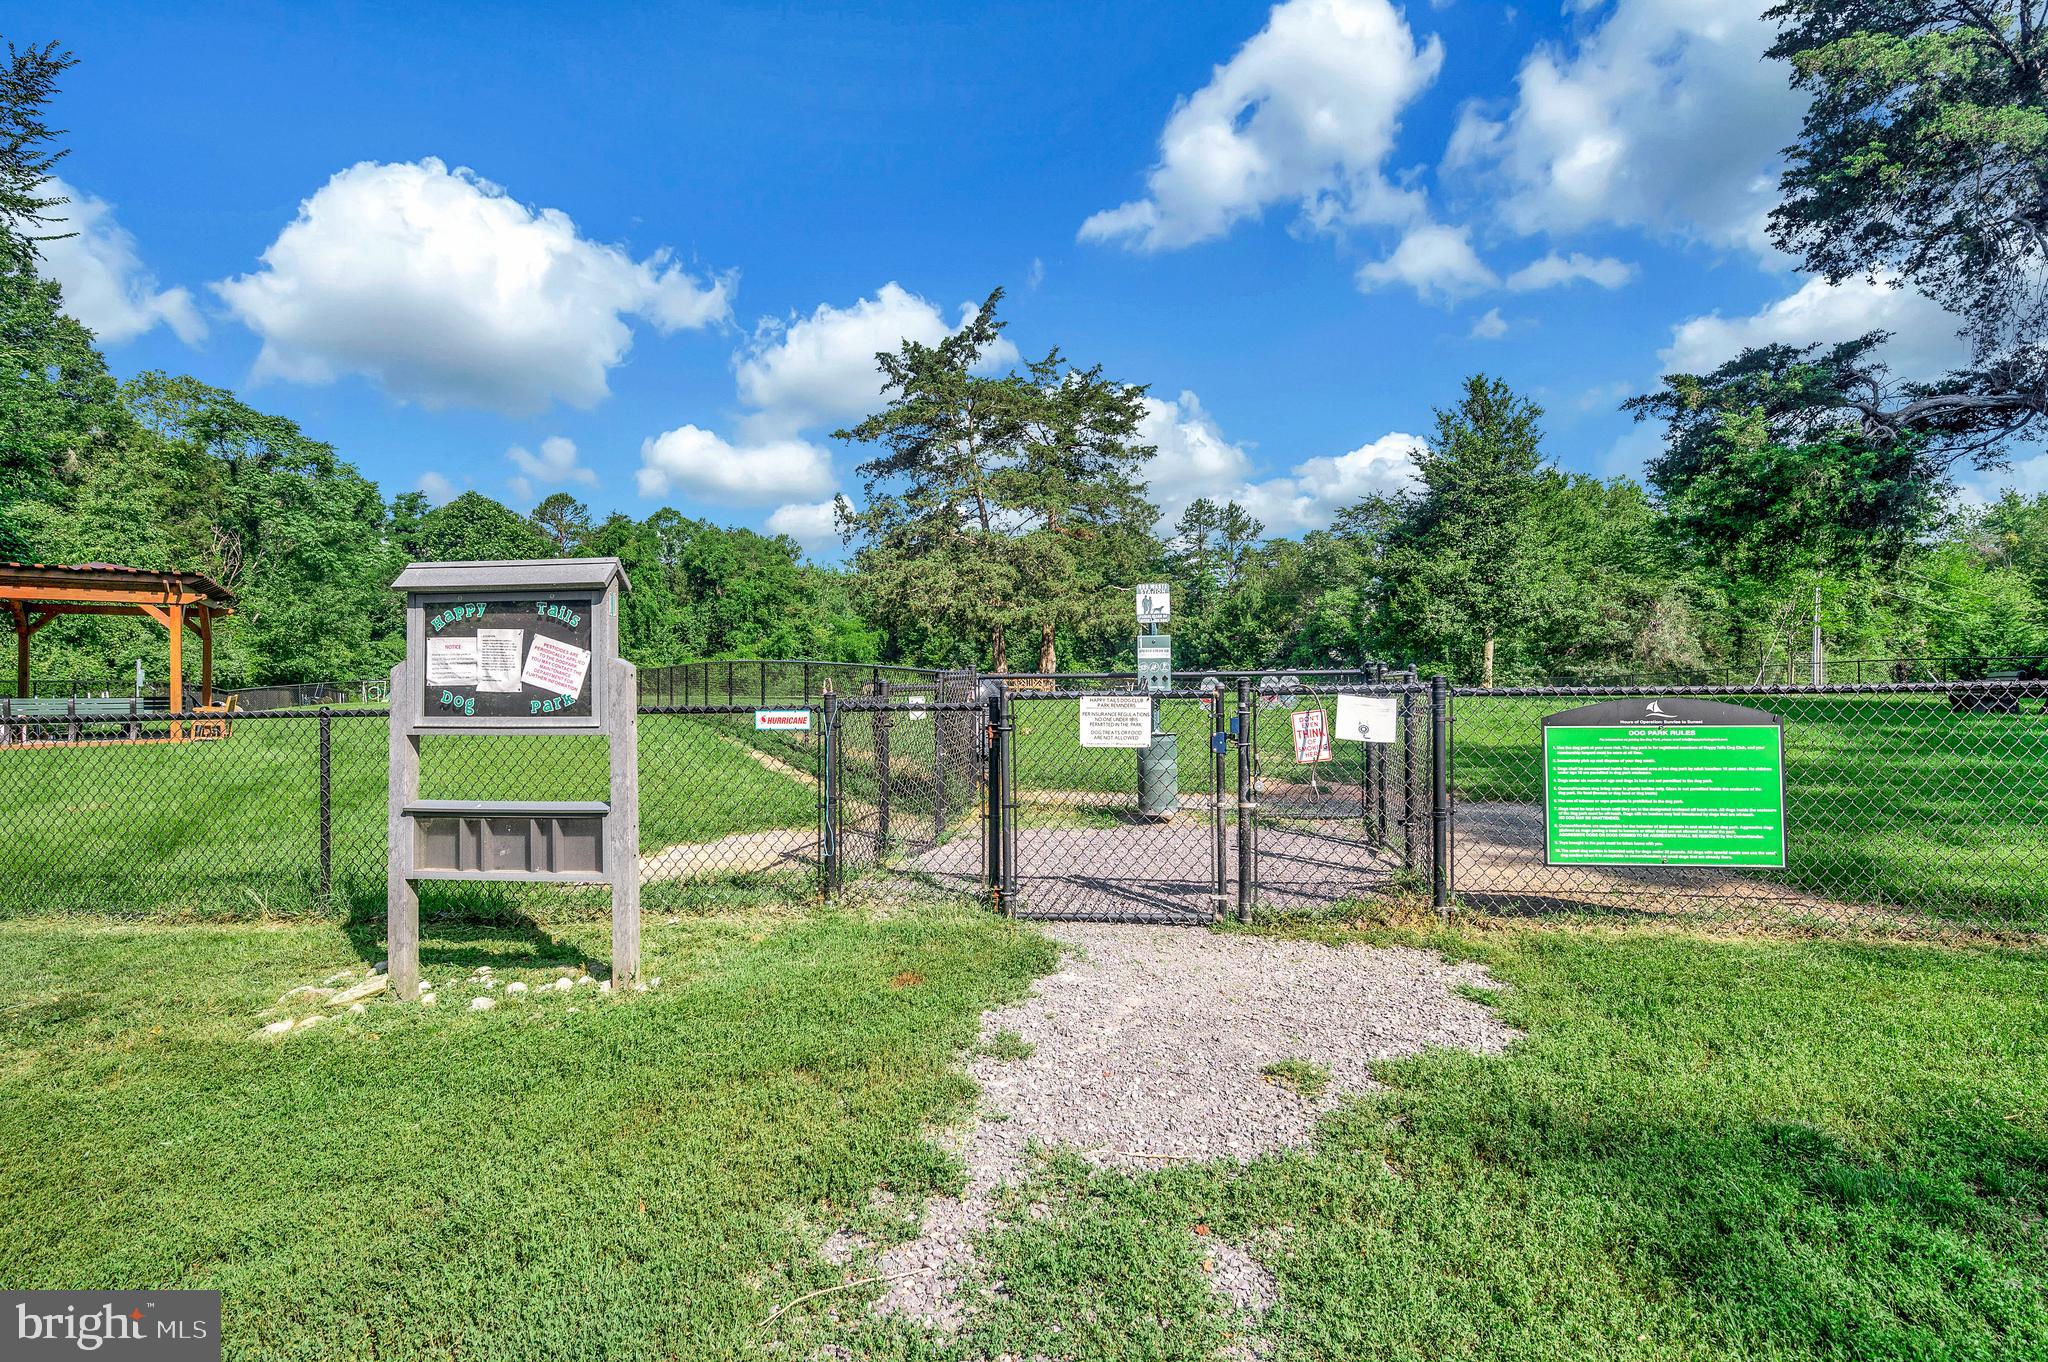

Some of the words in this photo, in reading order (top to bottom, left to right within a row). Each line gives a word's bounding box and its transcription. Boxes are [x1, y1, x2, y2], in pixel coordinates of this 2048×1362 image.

[430, 602, 486, 632] Happy
[536, 602, 581, 628] Tails
[441, 690, 475, 716] Dog
[531, 694, 576, 714] Park
[767, 716, 807, 724] HURRICANE
[1297, 728, 1325, 739] THINK
[1299, 744, 1328, 752] SMOKING
